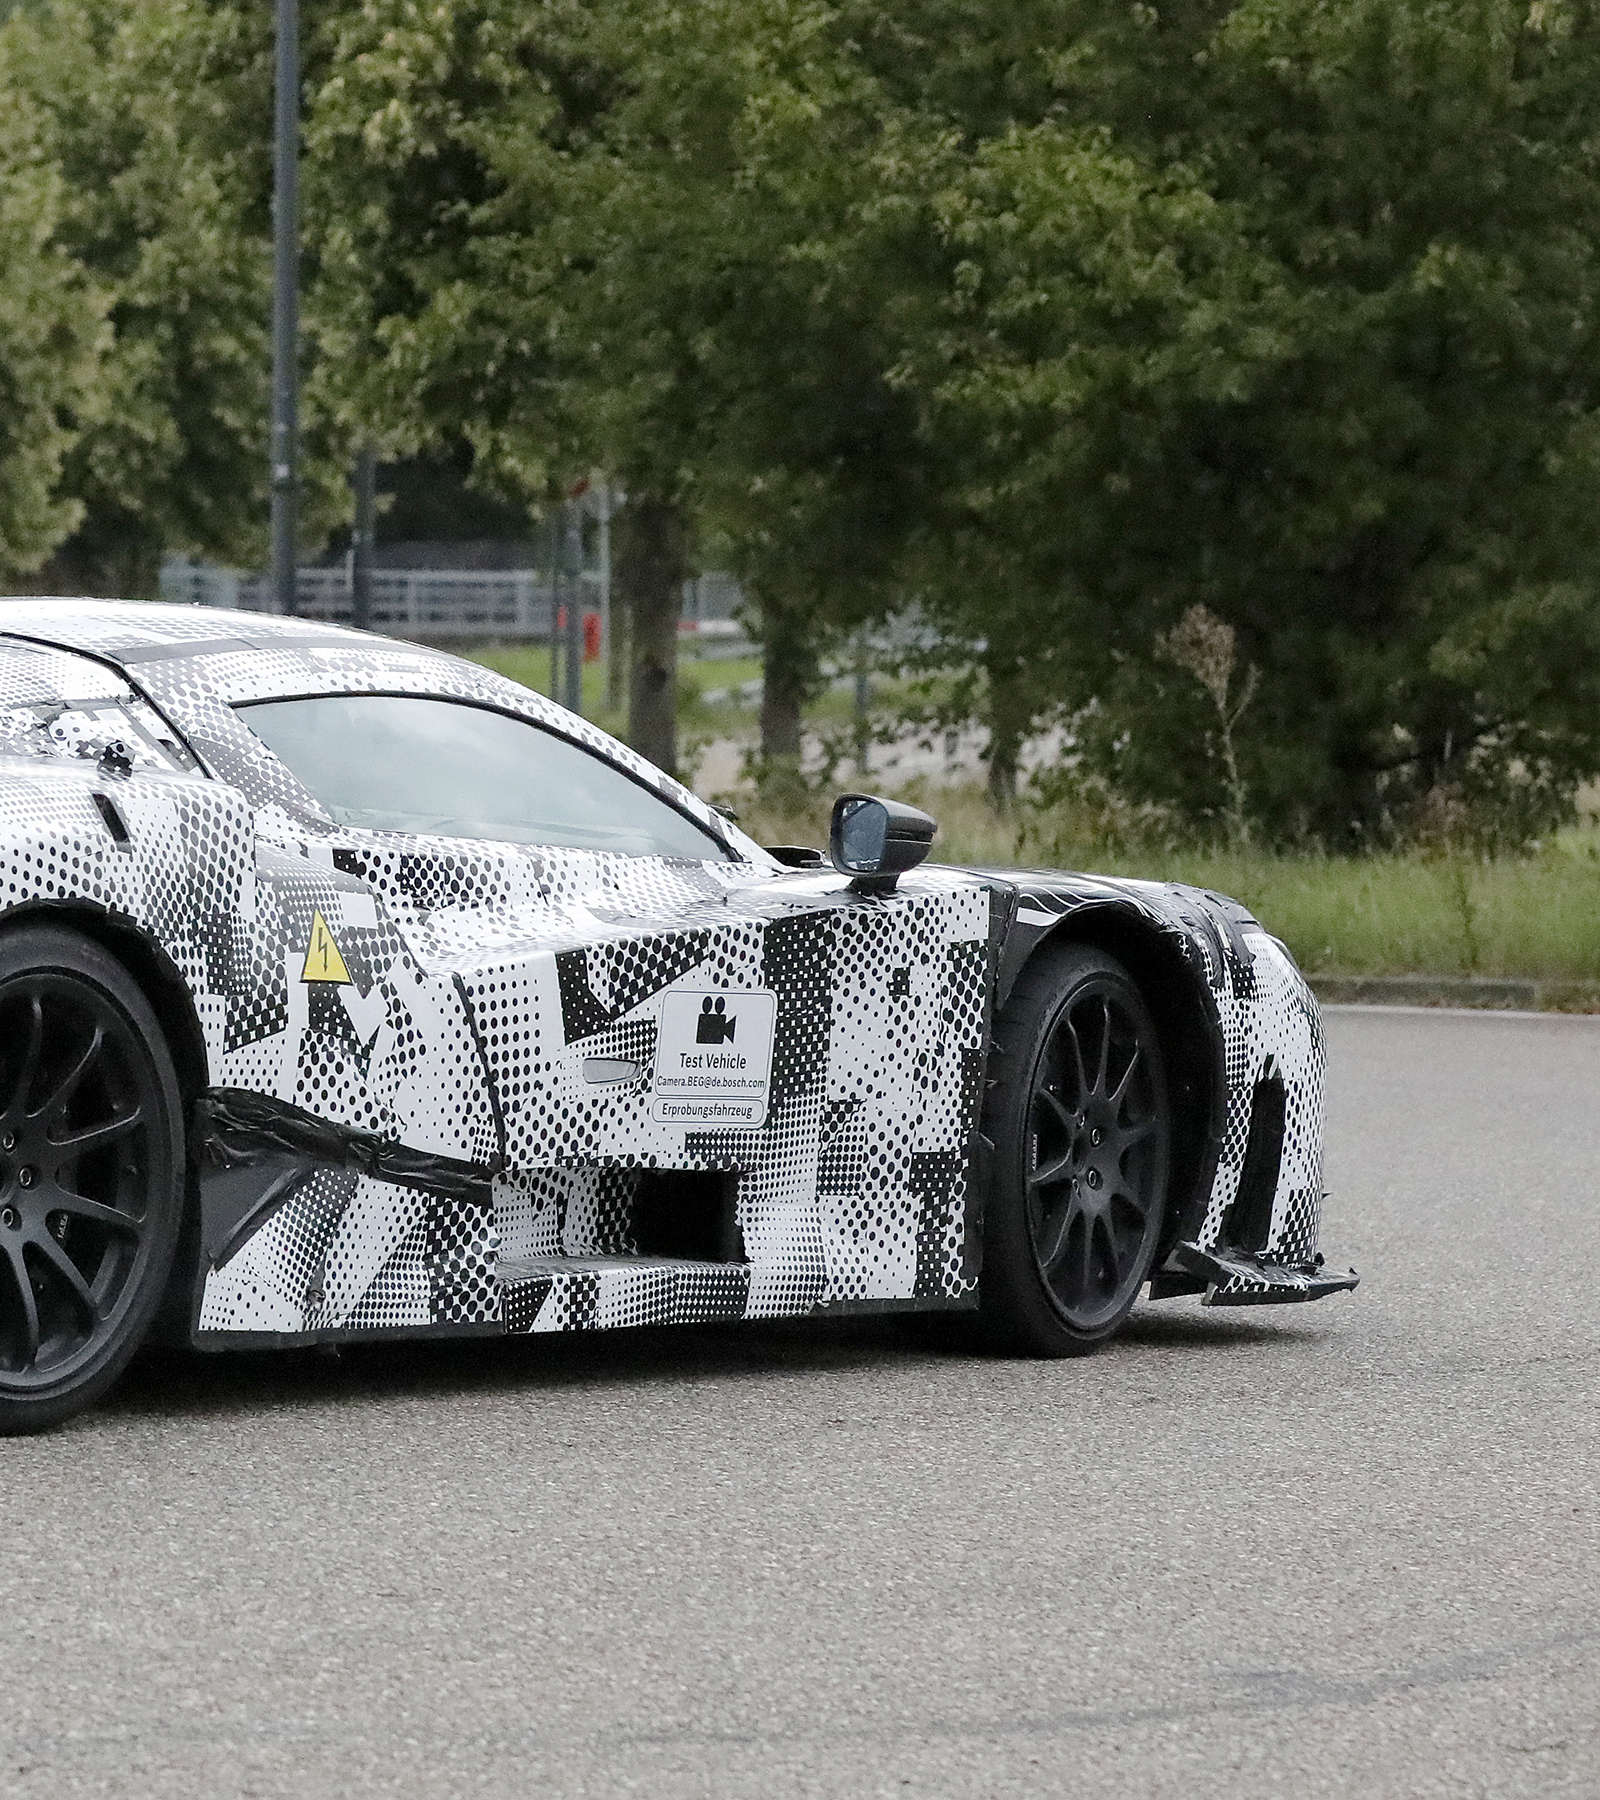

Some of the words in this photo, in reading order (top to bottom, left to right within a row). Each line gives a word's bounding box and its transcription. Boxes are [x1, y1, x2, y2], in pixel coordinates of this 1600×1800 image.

[680, 1053, 703, 1068] Test
[706, 1053, 747, 1069] Vehicle
[657, 1075, 765, 1089] Camera.BEG@de.bosch.com
[662, 1103, 753, 1119] Erprobungsfahrzeug
